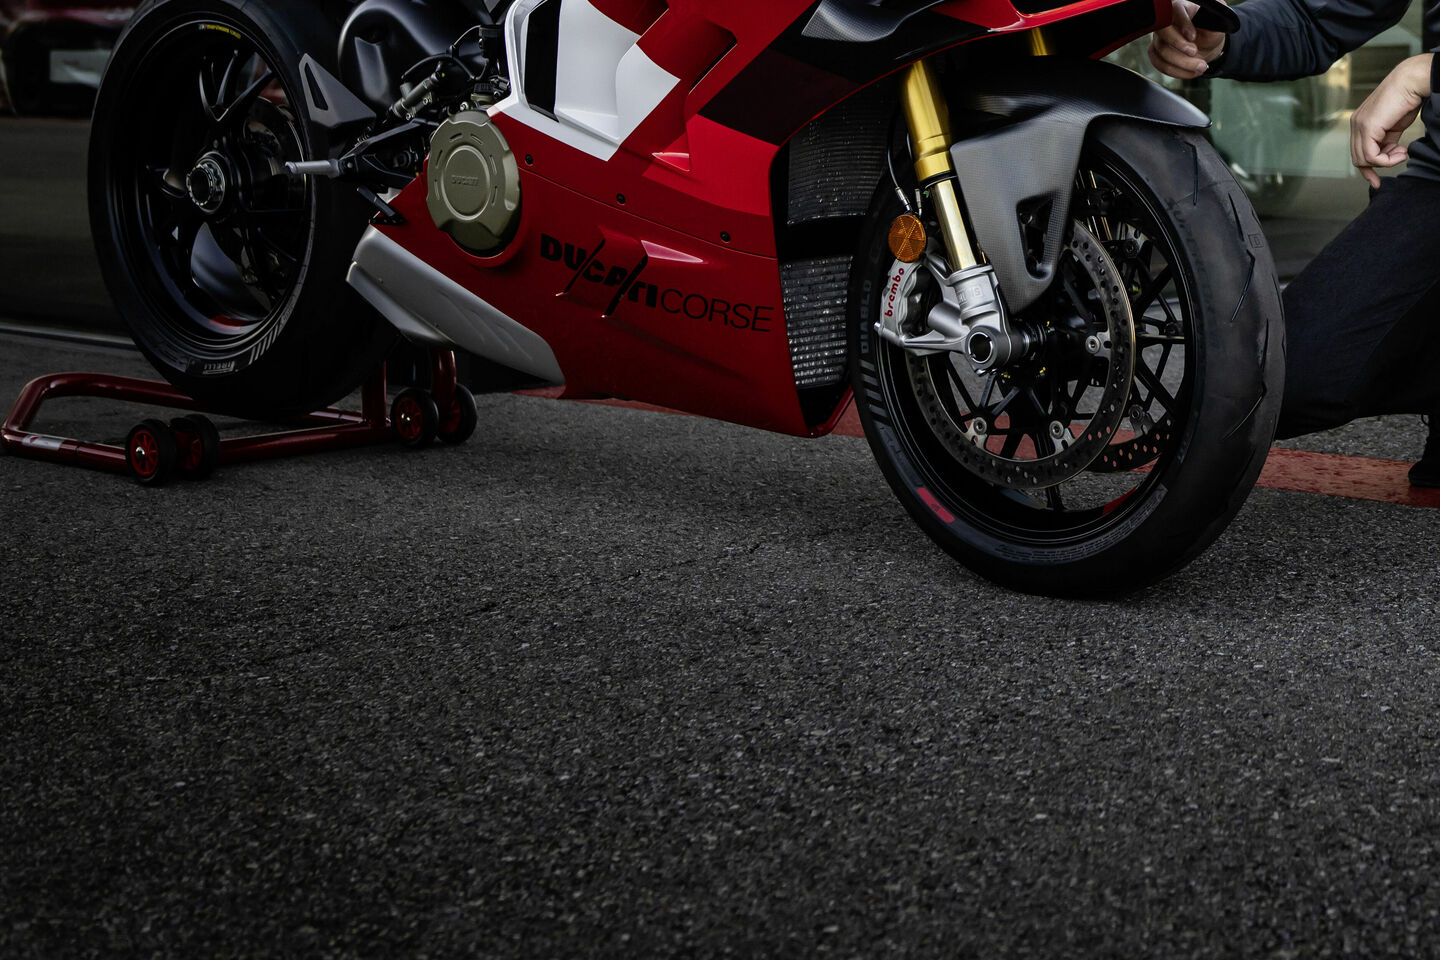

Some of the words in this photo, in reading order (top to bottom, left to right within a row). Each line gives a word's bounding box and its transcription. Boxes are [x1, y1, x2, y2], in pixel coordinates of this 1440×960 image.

[540, 234, 658, 310] DUCATI
[661, 289, 774, 332] CORSE
[884, 267, 905, 318] brembo
[860, 279, 872, 354] DIABLO
[203, 361, 235, 375] PIRELLI
